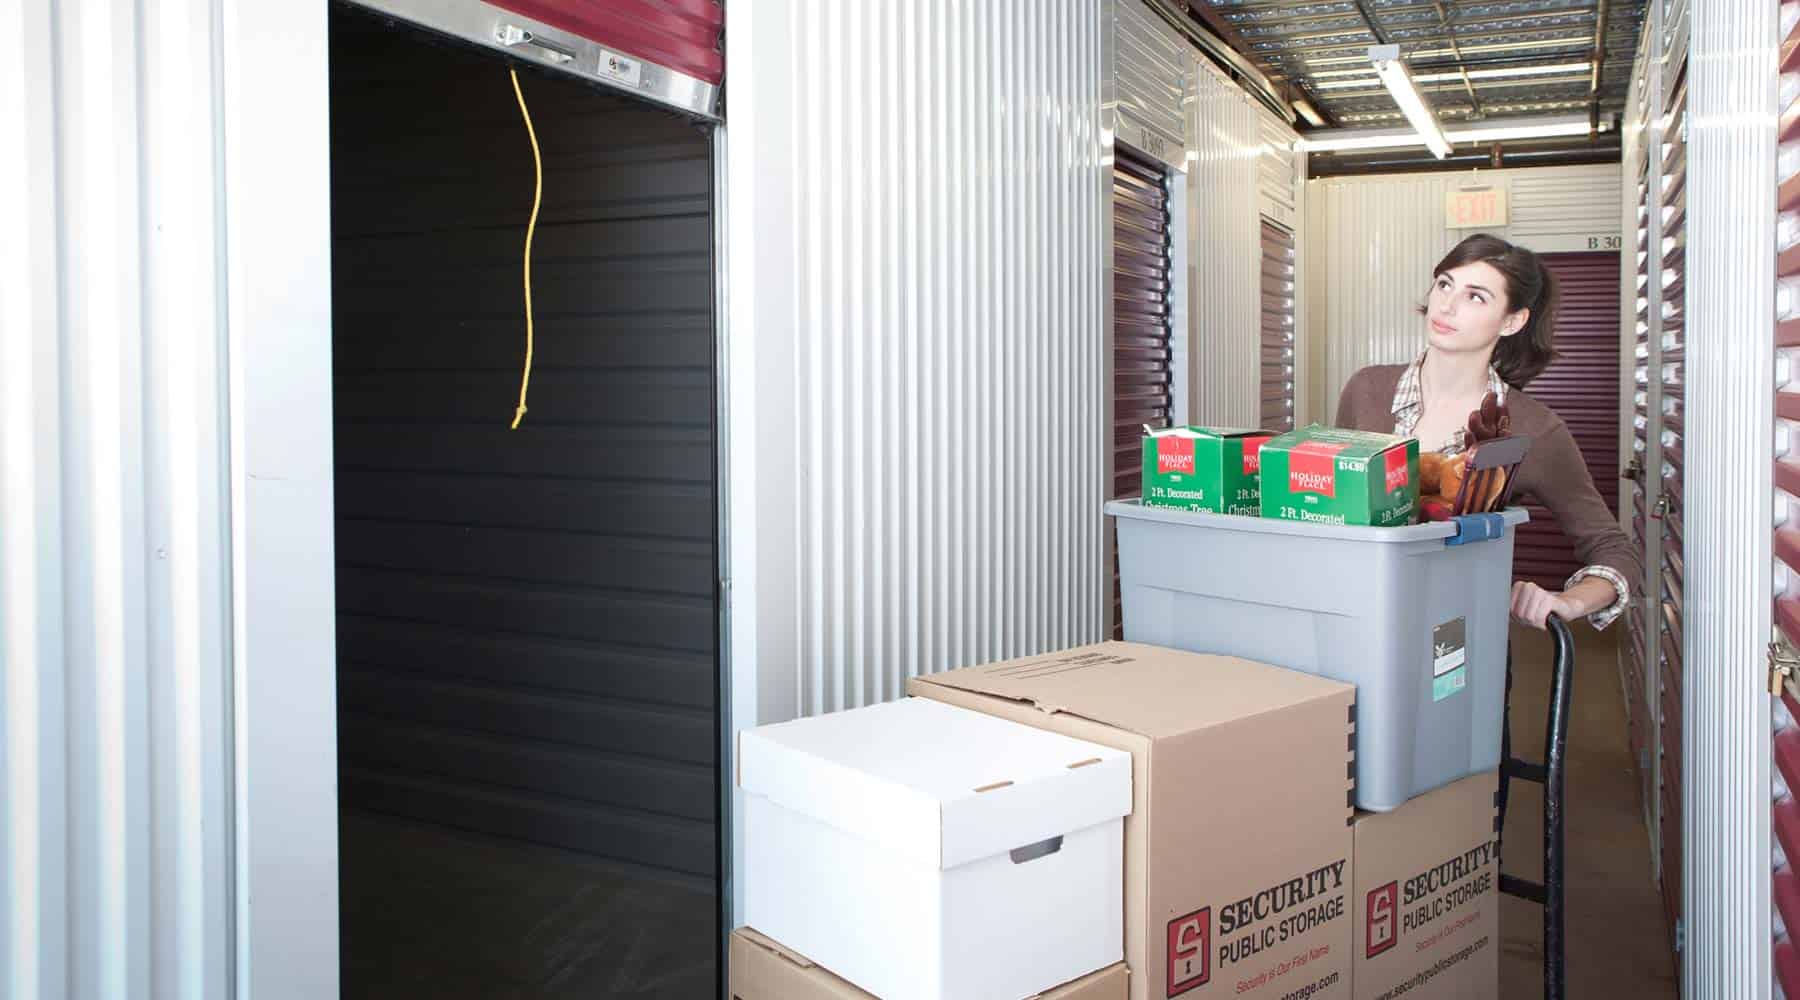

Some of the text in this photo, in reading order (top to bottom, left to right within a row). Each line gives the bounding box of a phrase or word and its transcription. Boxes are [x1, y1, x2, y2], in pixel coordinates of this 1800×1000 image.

[1456, 194, 1497, 223] EXIT
[1588, 237, 1598, 249] B
[1159, 454, 1193, 463] HOLIDAY
[1290, 471, 1332, 484] HOLIDAY
[1152, 487, 1157, 497] 2
[1167, 488, 1204, 500] Decorated
[1280, 506, 1345, 526] 2 Ft. Decorated
[1403, 840, 1492, 905] SECURITY
[1219, 858, 1346, 936] SECURITY
[1403, 872, 1491, 934] PUBLIC STORAGE
[1219, 895, 1344, 968] PUBLIC STORAGE
[1236, 970, 1268, 994] Security
